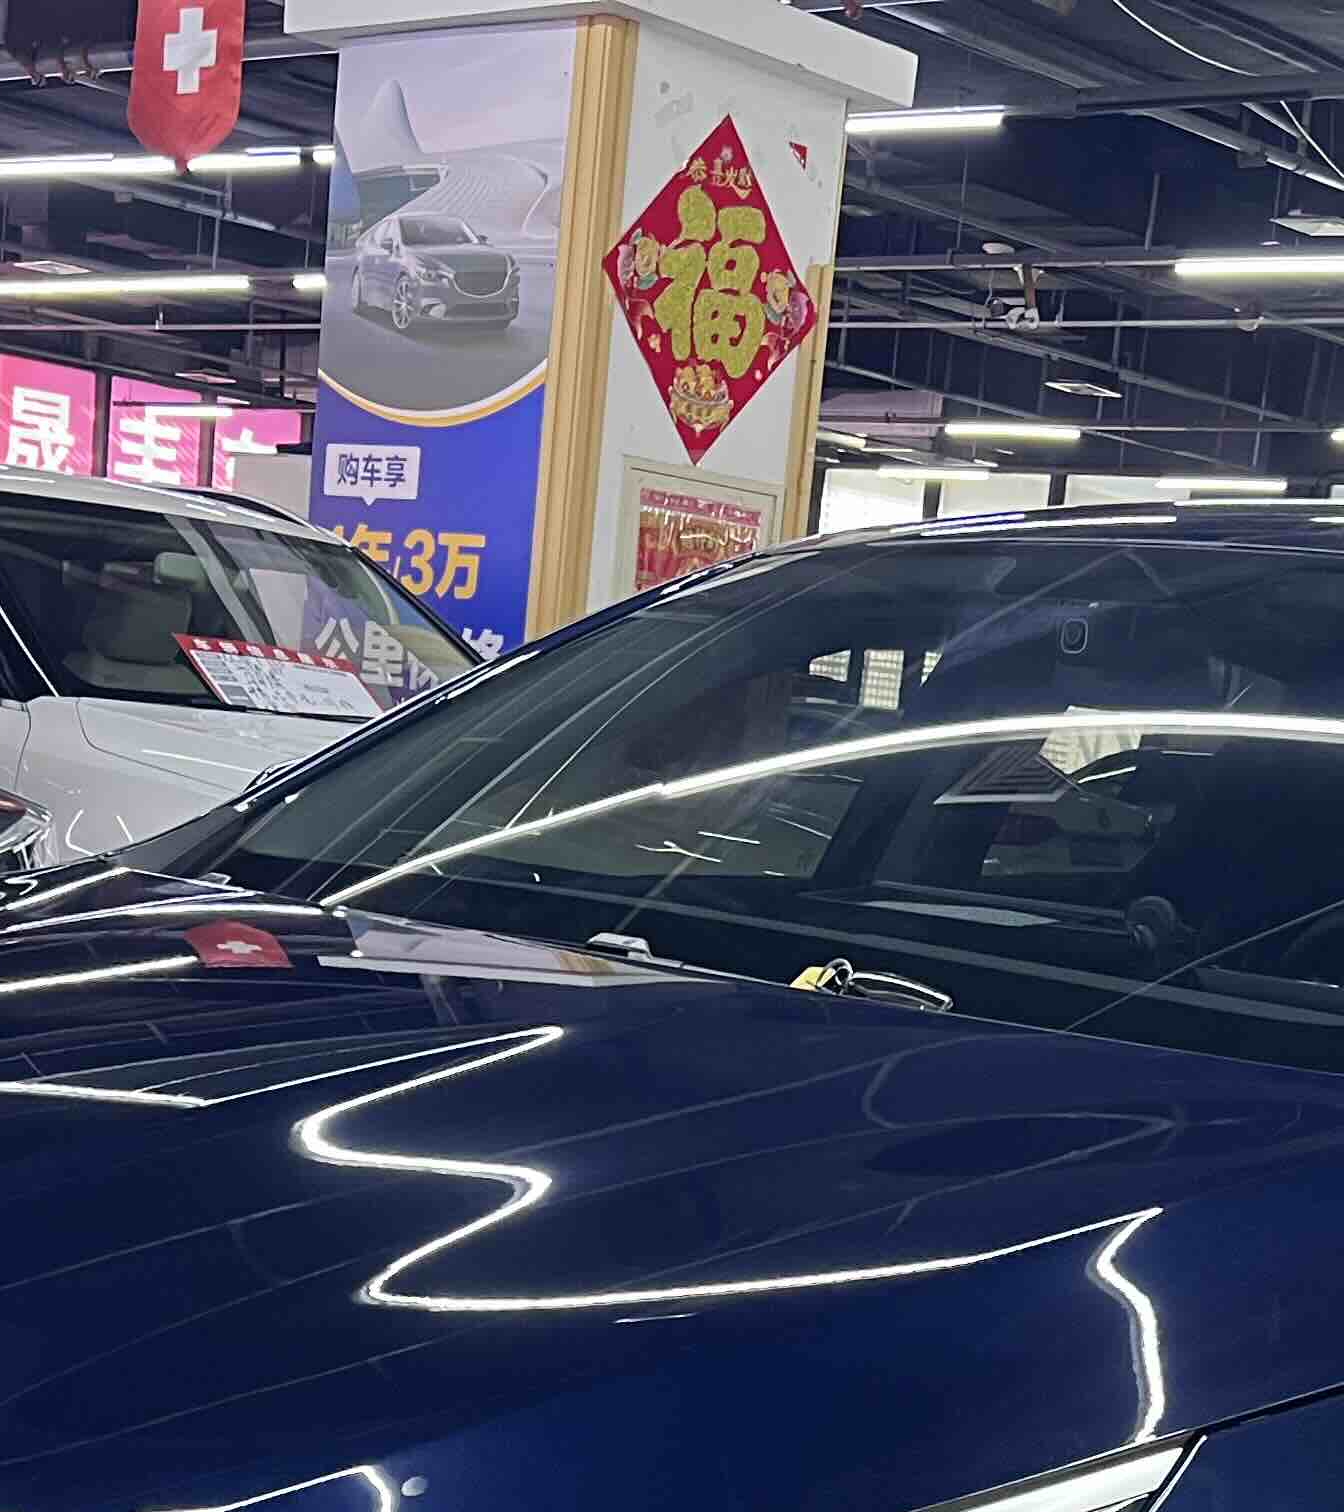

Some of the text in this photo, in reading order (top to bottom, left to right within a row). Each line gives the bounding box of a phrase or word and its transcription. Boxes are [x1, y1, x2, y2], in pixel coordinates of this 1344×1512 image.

[654, 186, 766, 380] 福
[337, 453, 408, 488] 购车享
[335, 524, 486, 601] 年/3万
